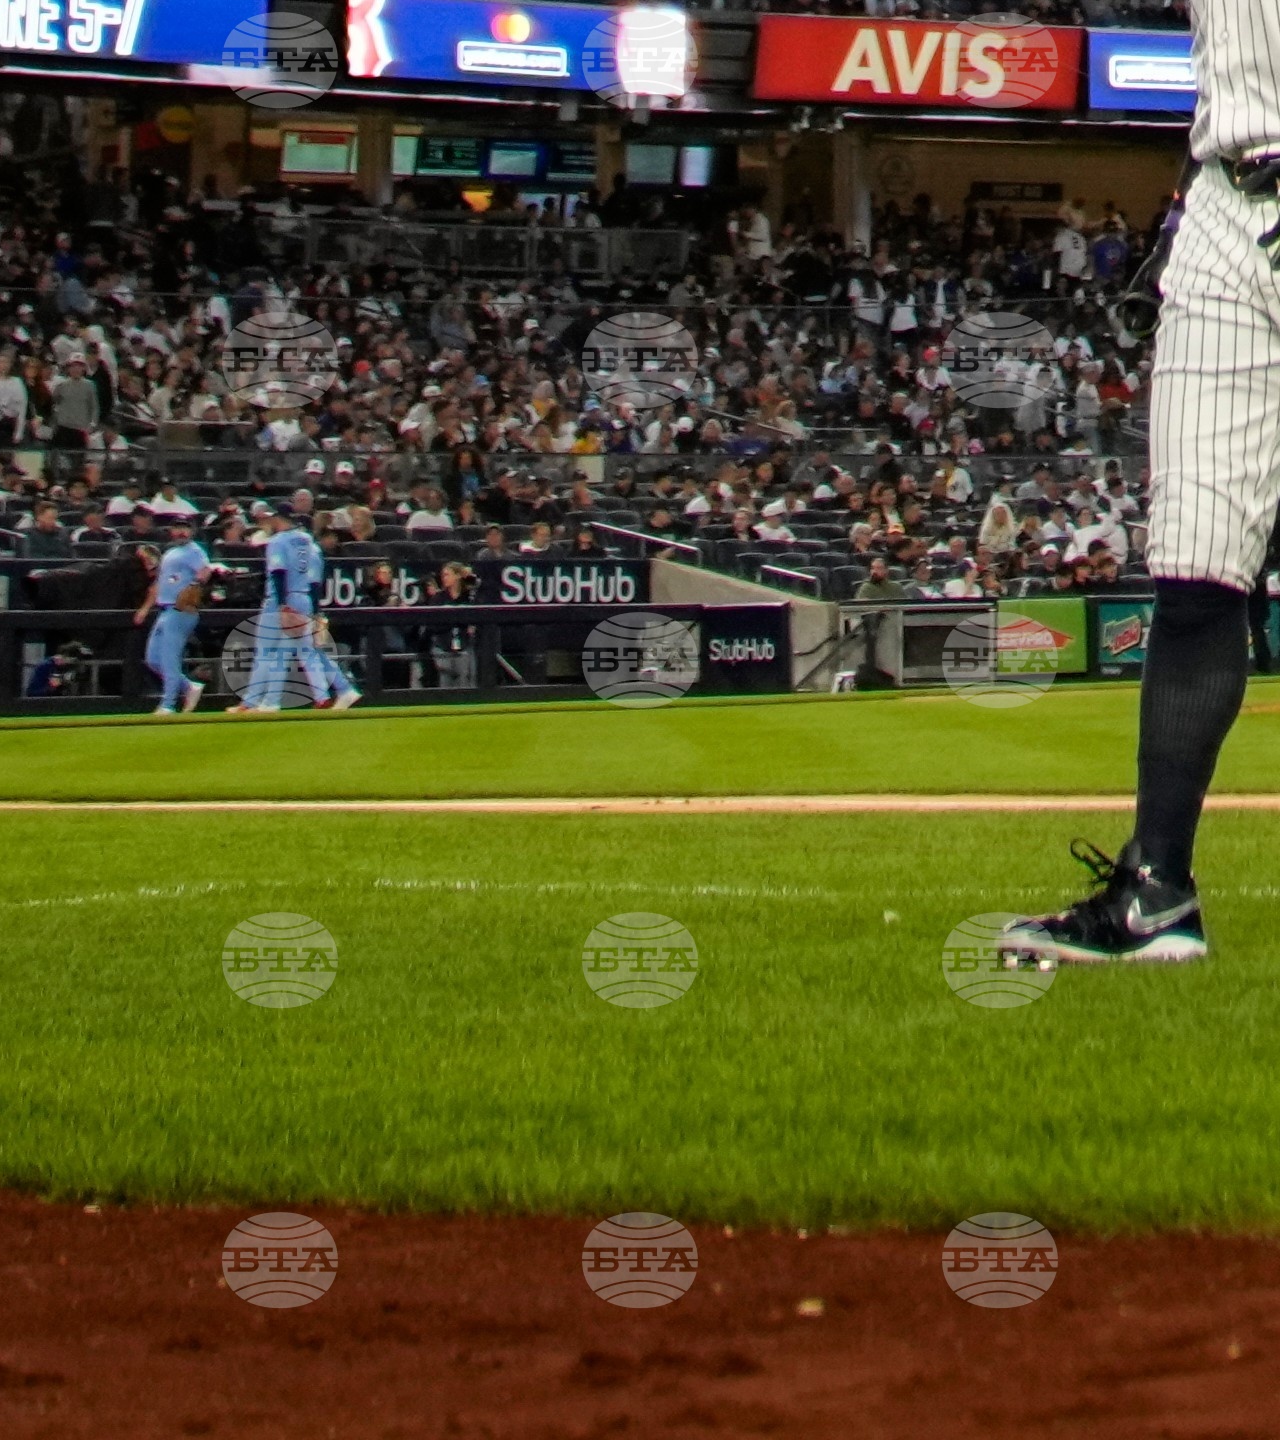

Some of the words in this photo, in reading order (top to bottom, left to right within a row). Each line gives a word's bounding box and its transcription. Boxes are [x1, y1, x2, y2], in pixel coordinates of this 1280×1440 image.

[830, 28, 1009, 99] AVIS
[500, 565, 636, 605] StubHub
[707, 637, 776, 662] StubHub
